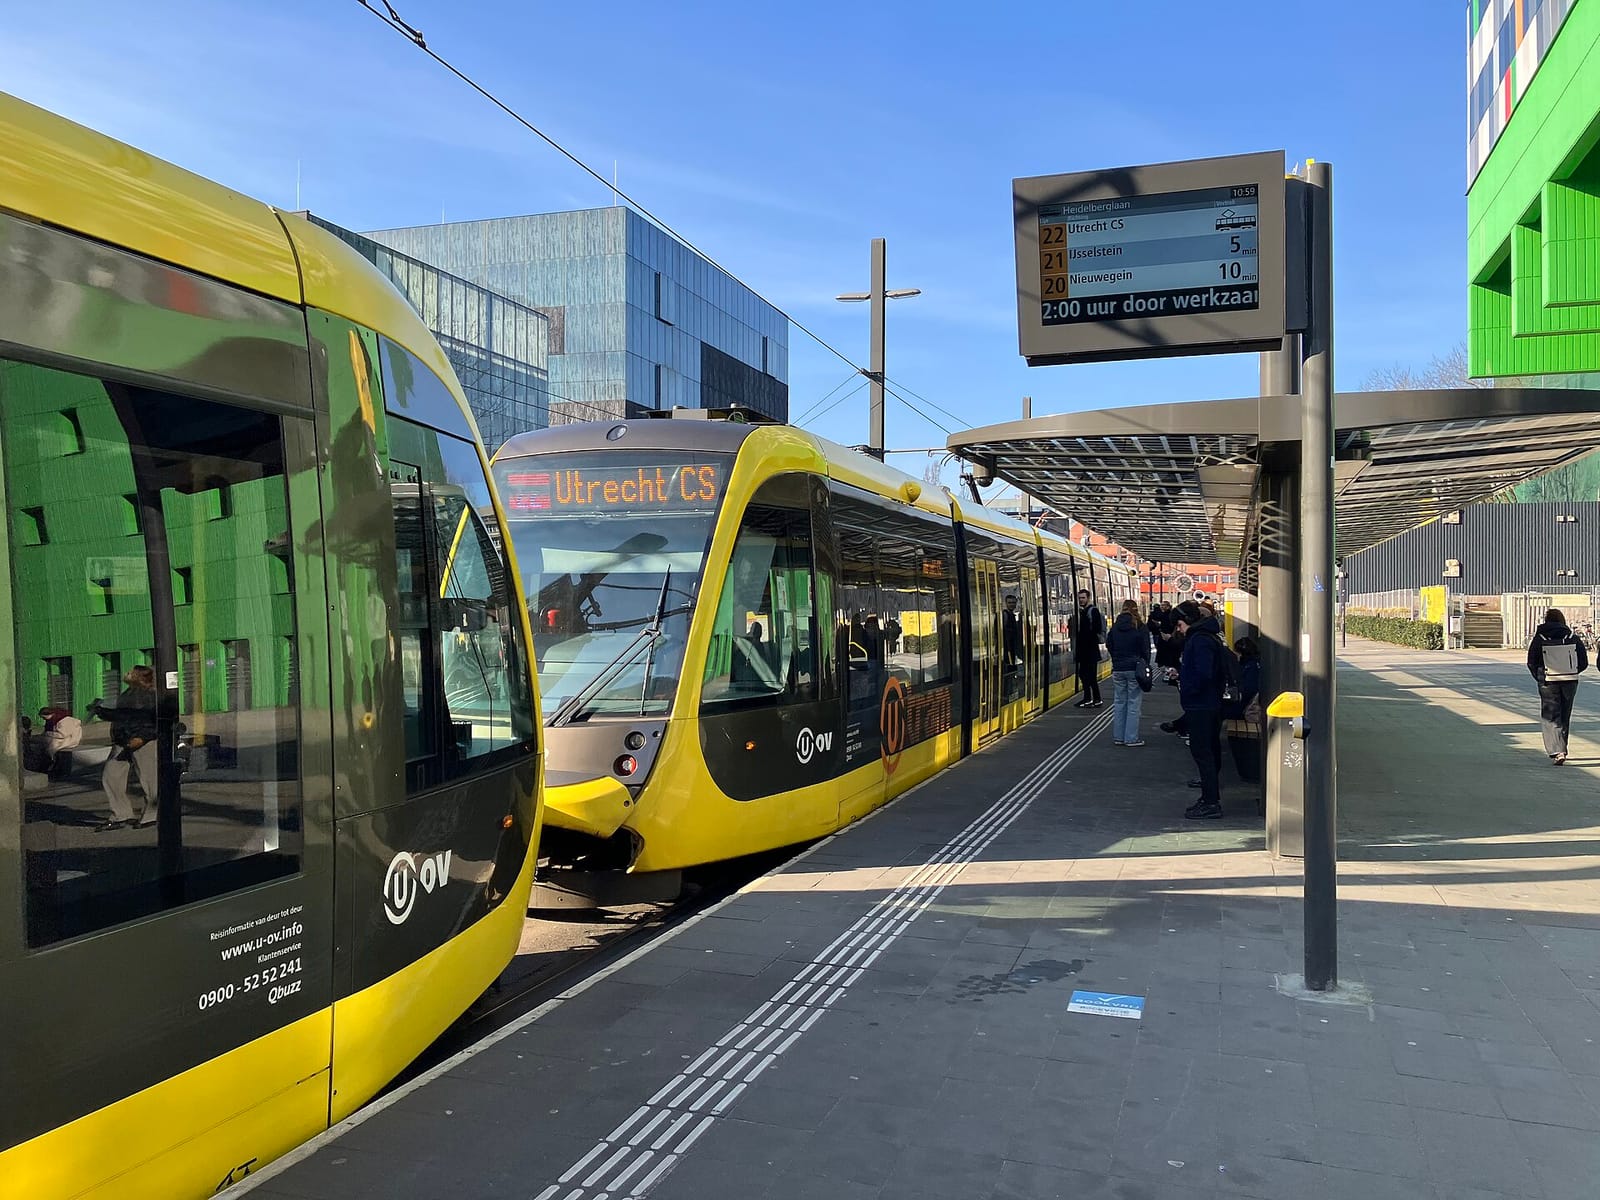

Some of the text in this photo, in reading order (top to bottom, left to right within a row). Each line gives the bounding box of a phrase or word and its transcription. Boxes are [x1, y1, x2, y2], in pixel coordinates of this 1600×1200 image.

[1233, 187, 1255, 197] 10:59
[1063, 201, 1130, 215] Heidelberglaan
[1043, 219, 1124, 244] 22 Utrecht CS
[1044, 252, 1063, 269] 21
[1069, 245, 1122, 259] IJsselstein
[1230, 235, 1241, 253] 5
[1044, 262, 1257, 294] 20 Nieuwegein 10 min
[1086, 300, 1116, 316] uur
[1123, 295, 1166, 313] door
[1173, 288, 1258, 309] werkzaa
[555, 467, 667, 504] Utrecht
[680, 466, 716, 501] CS
[210, 904, 303, 941] Reisinformatie van deur tot deur
[221, 921, 303, 961] www.u-ov.info
[257, 942, 302, 963] Klantenservice
[198, 983, 234, 1010] 0900
[243, 974, 259, 993] 52
[262, 966, 278, 986] 52
[279, 957, 302, 978] 241
[268, 980, 302, 1004] Qbuzz
